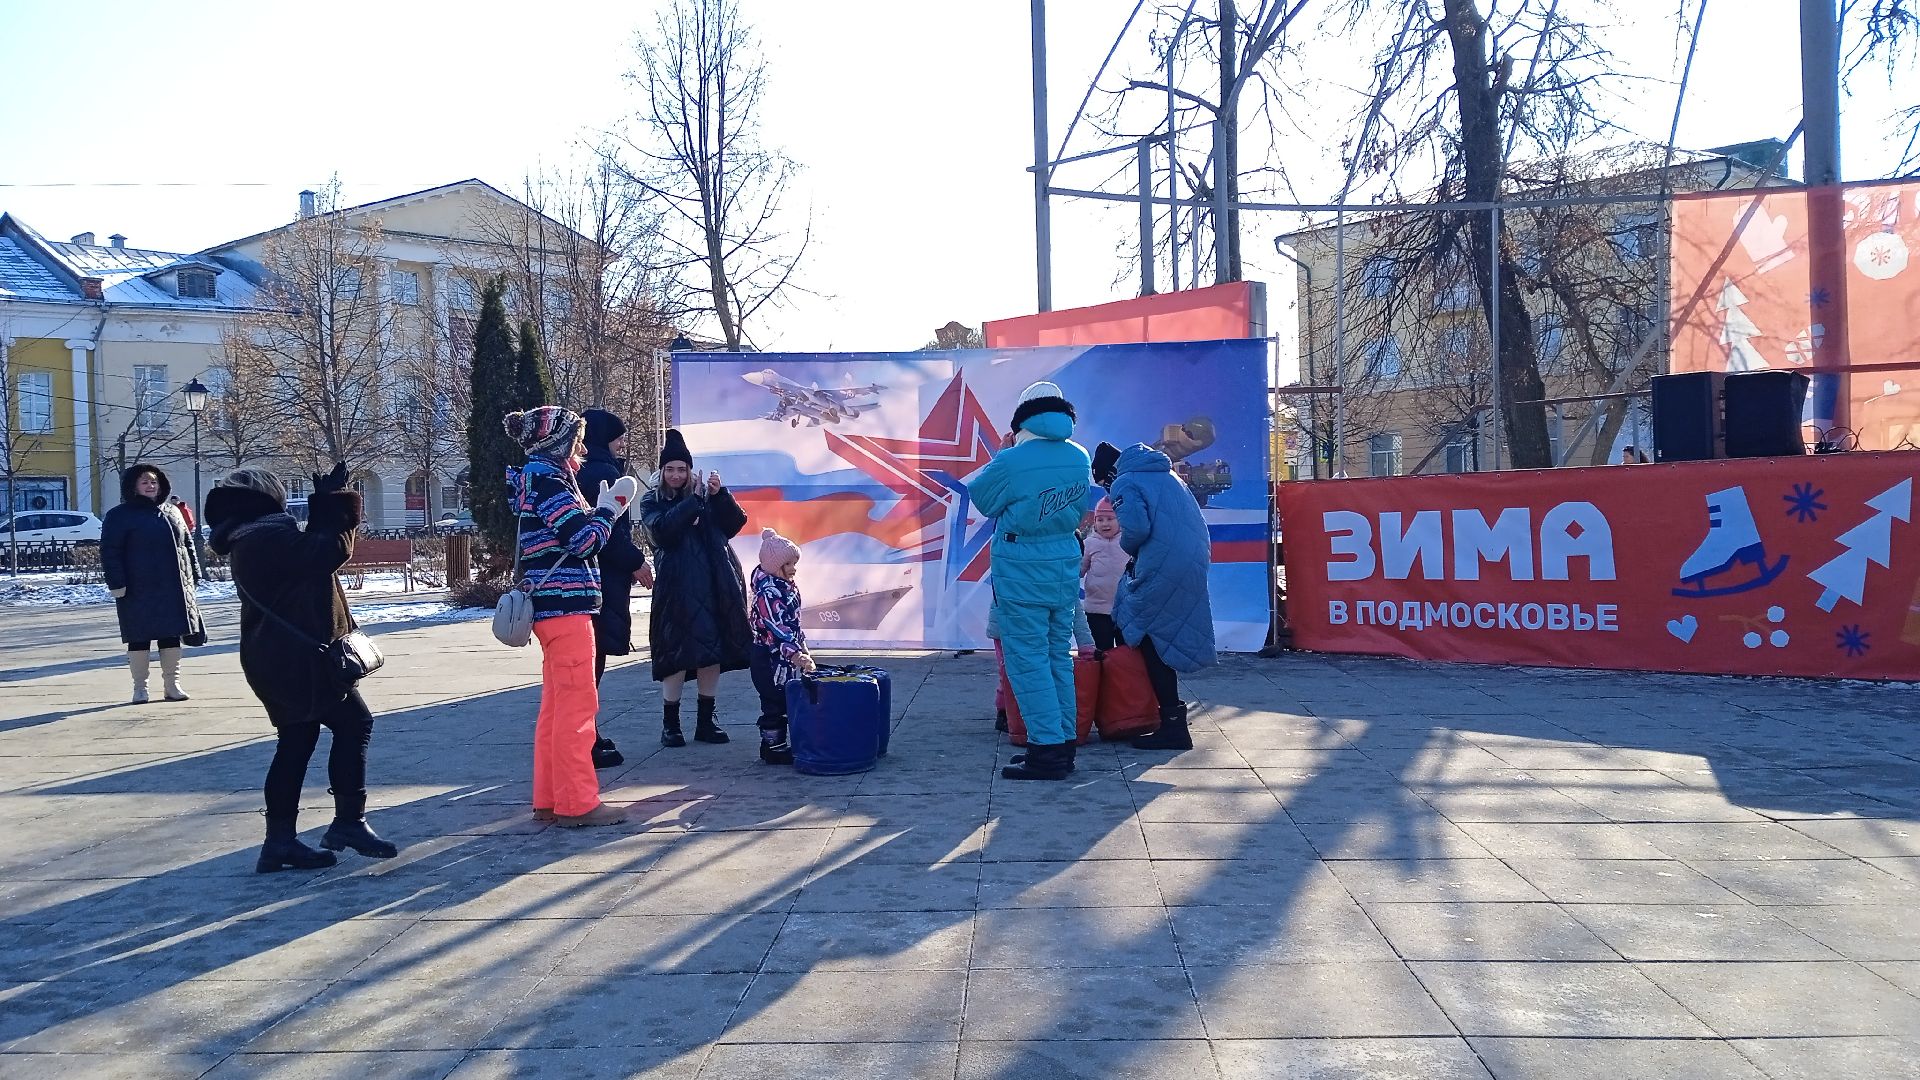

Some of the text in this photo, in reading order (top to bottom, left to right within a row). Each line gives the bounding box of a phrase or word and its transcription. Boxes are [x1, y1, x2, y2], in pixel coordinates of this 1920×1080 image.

[1323, 501, 1617, 581] ЗИМА
[818, 610, 841, 622] 099
[1328, 600, 1619, 632] В ПОДМОСКОВЬЕ
